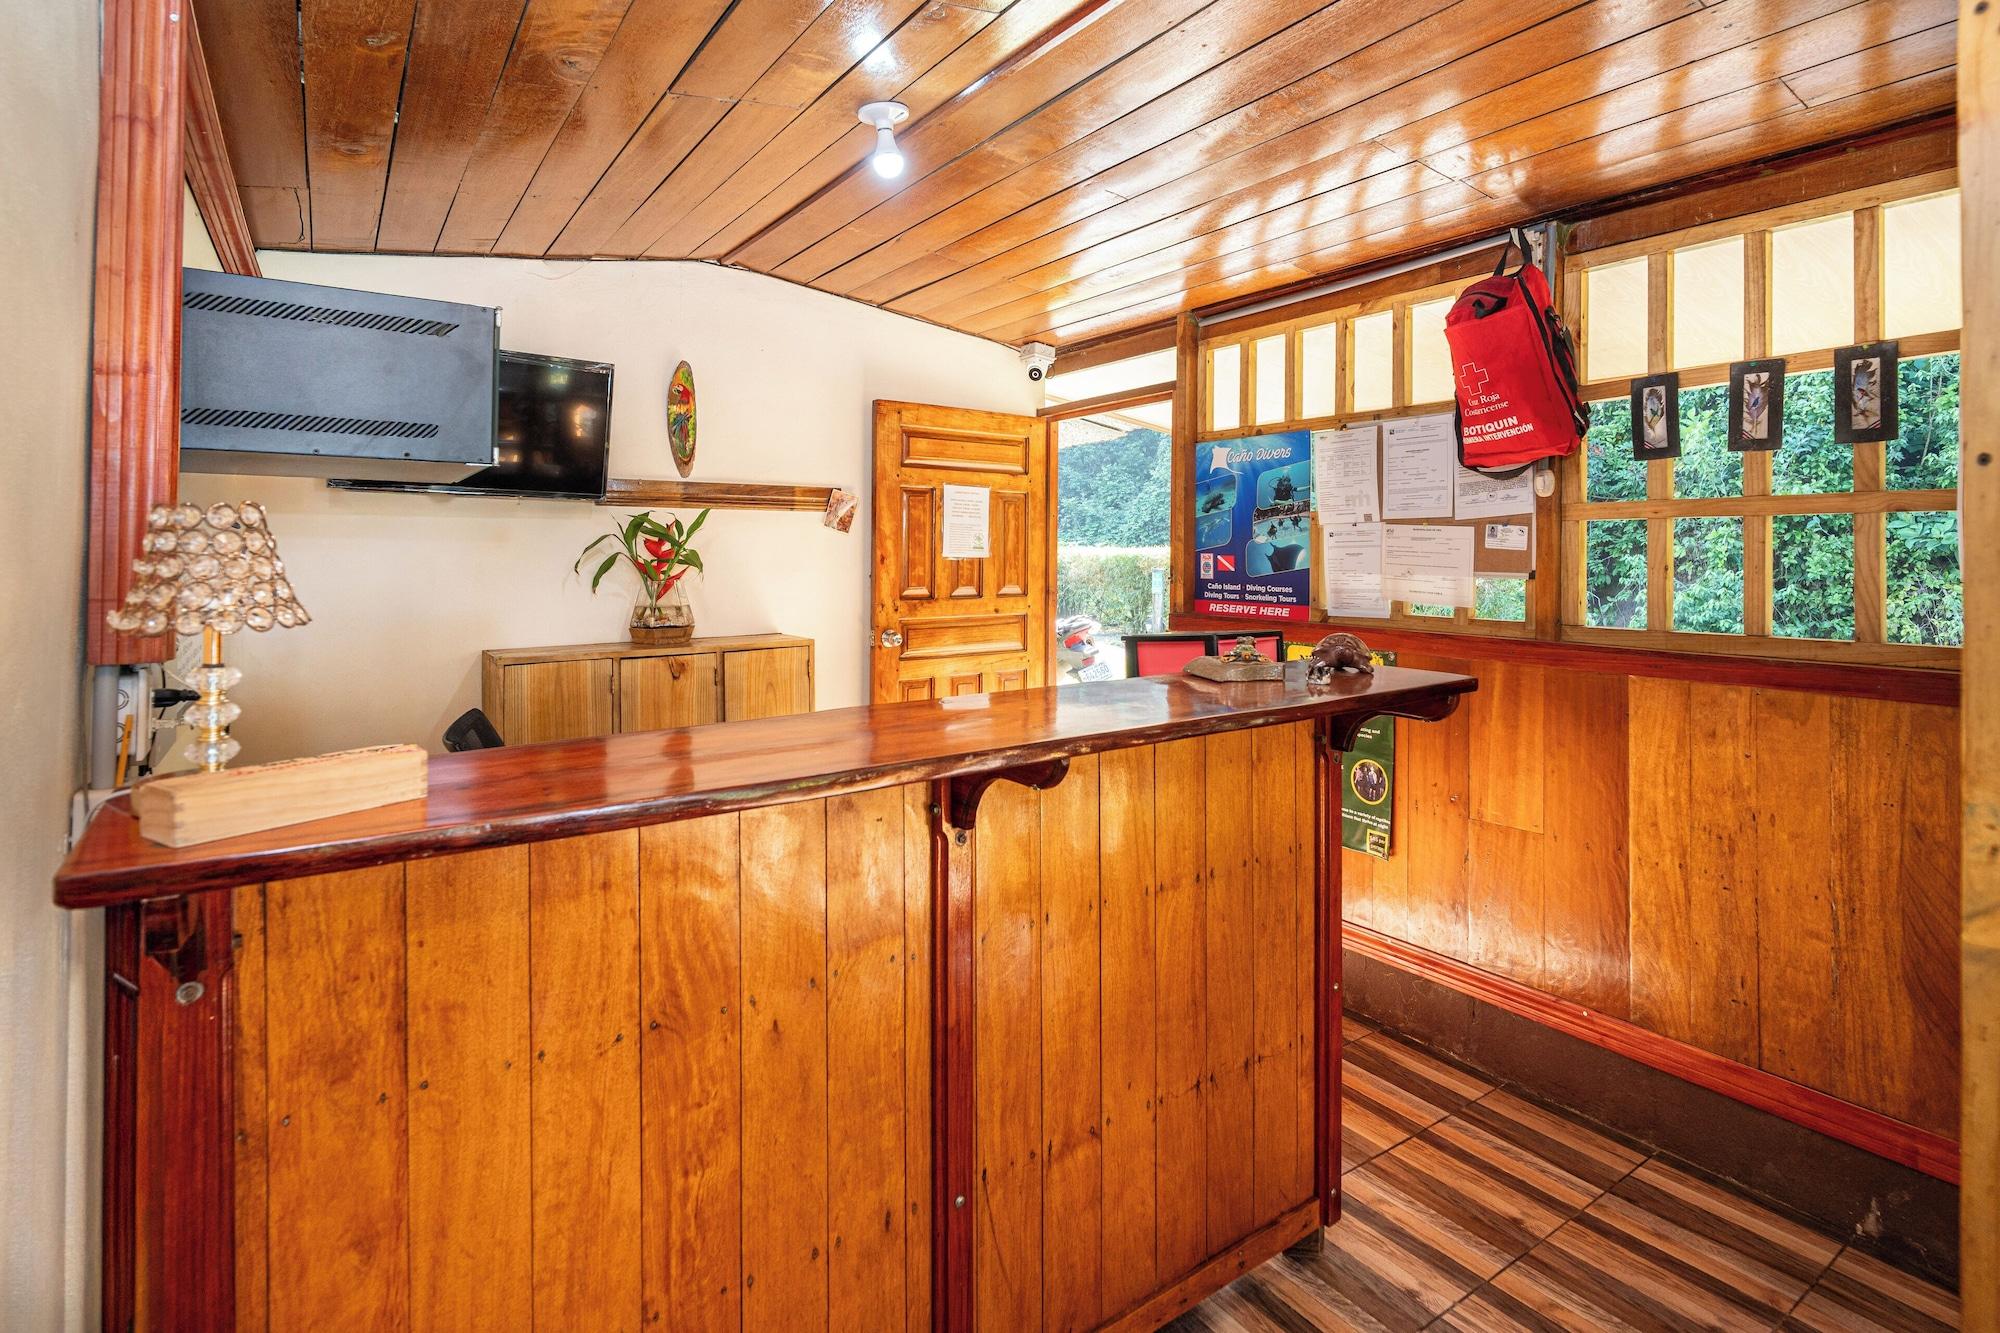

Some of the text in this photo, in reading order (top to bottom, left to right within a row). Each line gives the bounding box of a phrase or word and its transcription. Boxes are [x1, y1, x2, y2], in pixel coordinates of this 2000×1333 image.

[1480, 392, 1500, 404] Roja
[1463, 416, 1518, 437] BOTIQUIN
[1483, 422, 1534, 442] INTERVENCIÓN
[1227, 447, 1292, 463] Caño Divers
[1223, 583, 1241, 591] Island
[1246, 584, 1266, 593] Diving
[1267, 585, 1293, 593] Courses
[1204, 591, 1297, 603] Diving Tours Snorkeling Tours
[1209, 603, 1290, 617] RESERVE HERE
